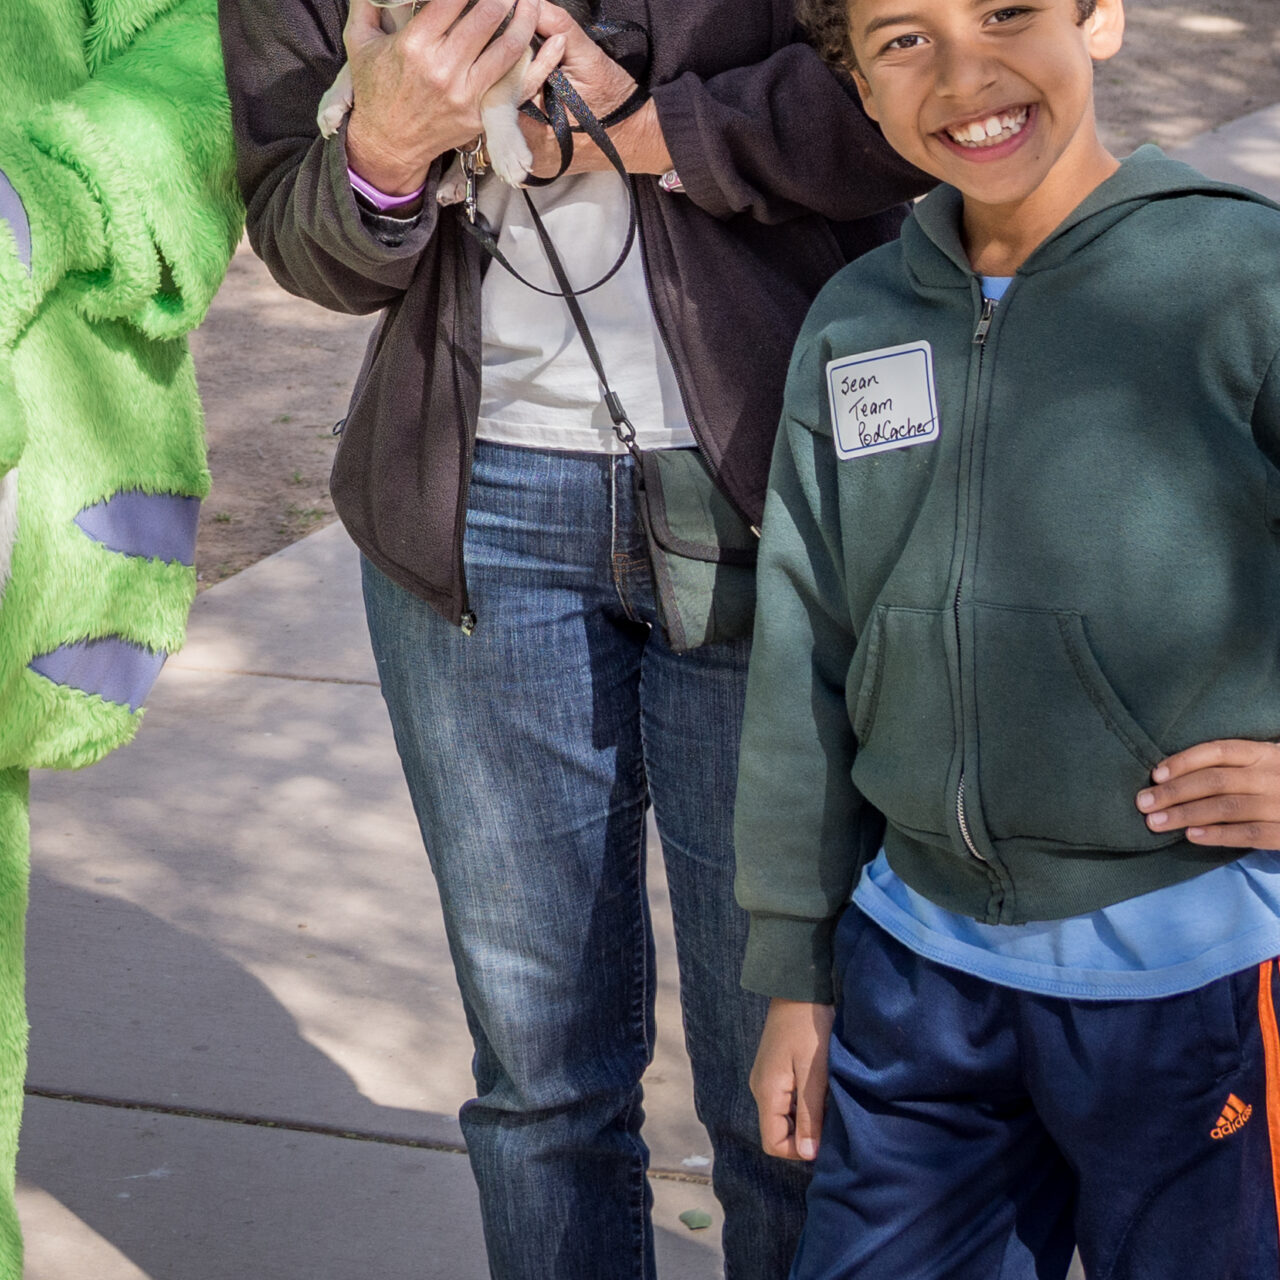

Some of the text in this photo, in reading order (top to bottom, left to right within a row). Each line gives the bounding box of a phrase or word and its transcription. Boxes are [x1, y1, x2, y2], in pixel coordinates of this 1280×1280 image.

[841, 375, 879, 395] Sean
[848, 396, 893, 421] Team
[858, 417, 937, 447] PodCacher
[1210, 1103, 1253, 1139] adidas
